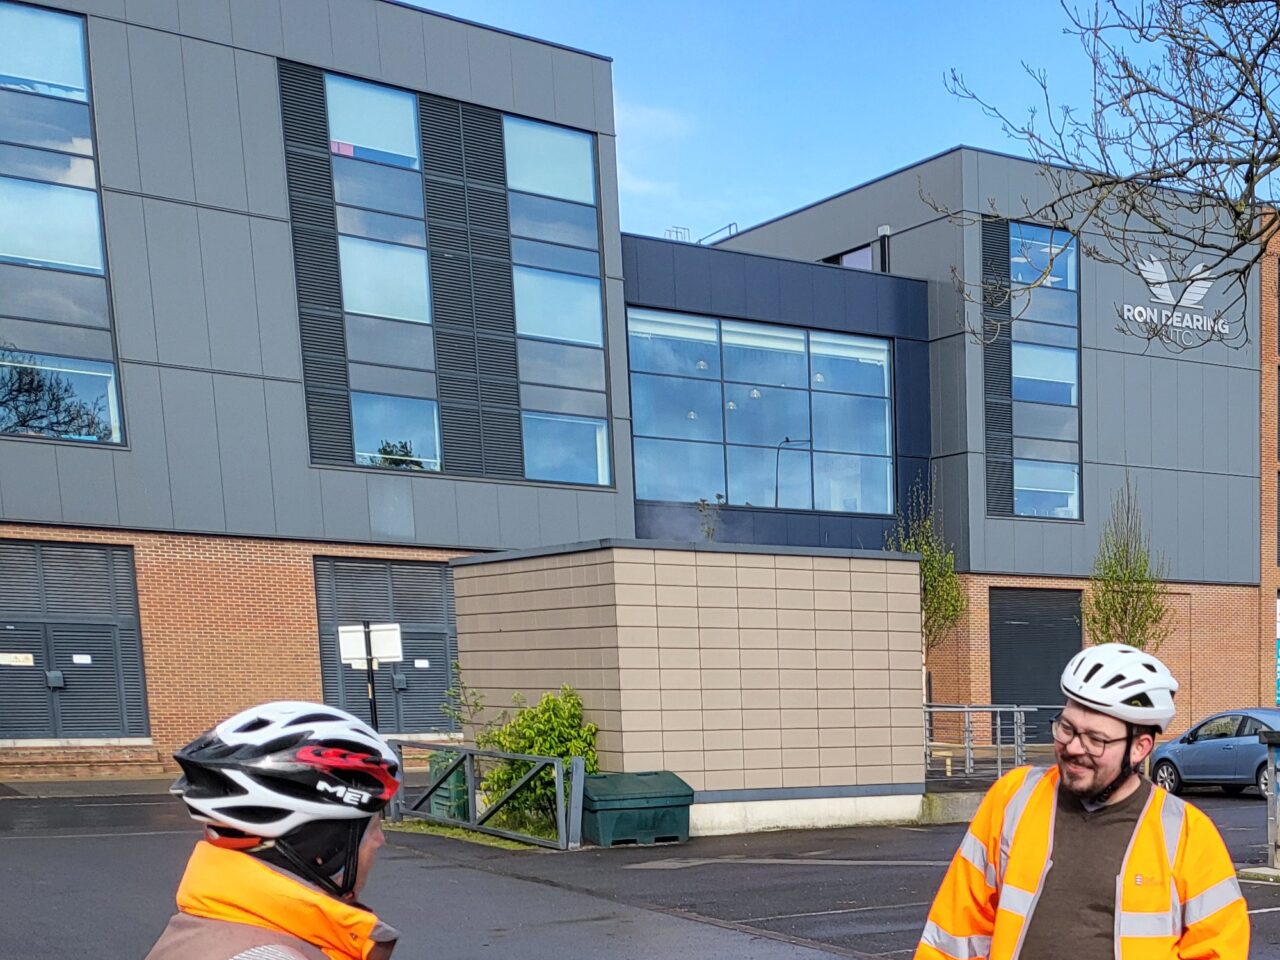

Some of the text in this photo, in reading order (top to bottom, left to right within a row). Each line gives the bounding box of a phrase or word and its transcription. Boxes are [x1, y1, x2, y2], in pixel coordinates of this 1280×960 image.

[1124, 304, 1229, 334] RON DEARING
[1162, 328, 1193, 346] UTC
[316, 780, 372, 805] MET
